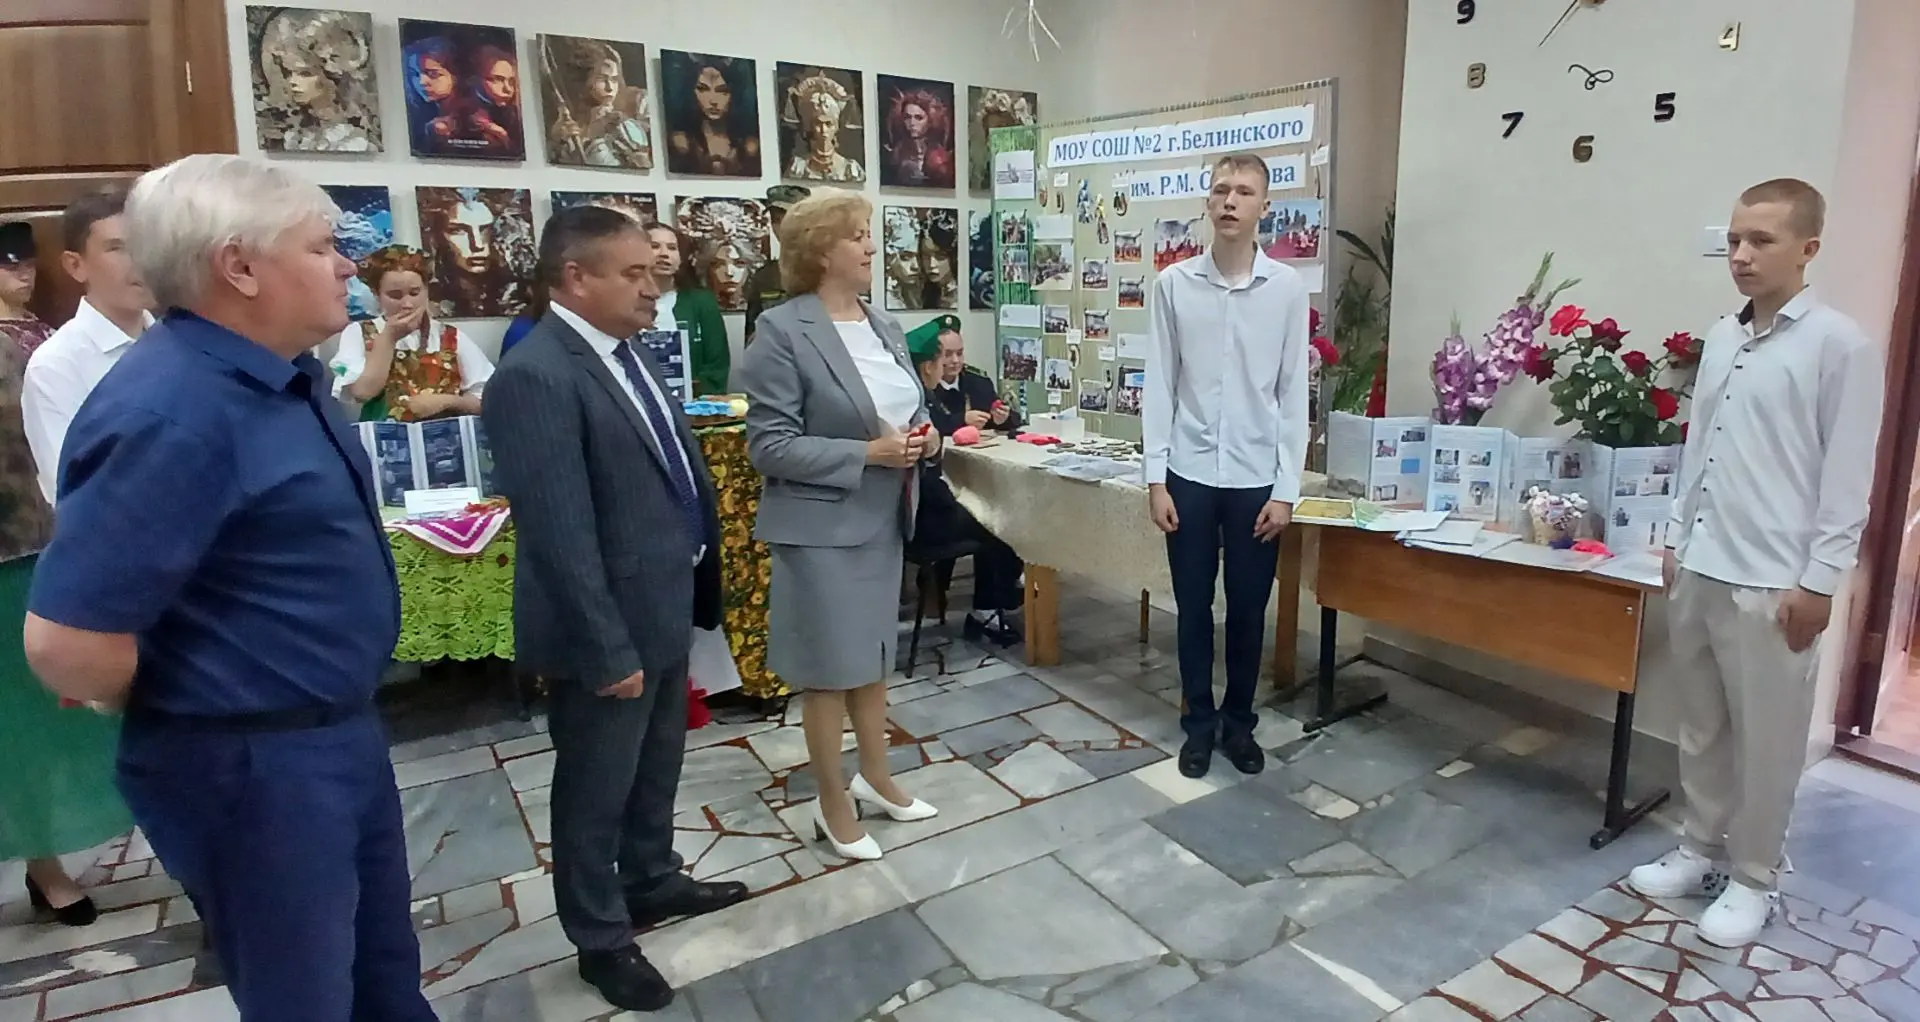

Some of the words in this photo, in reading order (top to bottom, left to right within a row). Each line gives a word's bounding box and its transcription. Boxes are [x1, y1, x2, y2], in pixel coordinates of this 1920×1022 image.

[1457, 0, 1476, 24] 9
[1718, 21, 1741, 51] 4
[1467, 62, 1486, 89] 8
[1654, 92, 1676, 122] 5
[1502, 112, 1524, 138] 7
[1055, 140, 1088, 162] МОУ
[1092, 136, 1129, 157] СОШ
[1134, 133, 1162, 155] №2
[1168, 119, 1304, 152] г.Белинского
[1572, 135, 1595, 163] 6
[1131, 182, 1155, 197] им.
[1160, 173, 1194, 196] Р.М.
